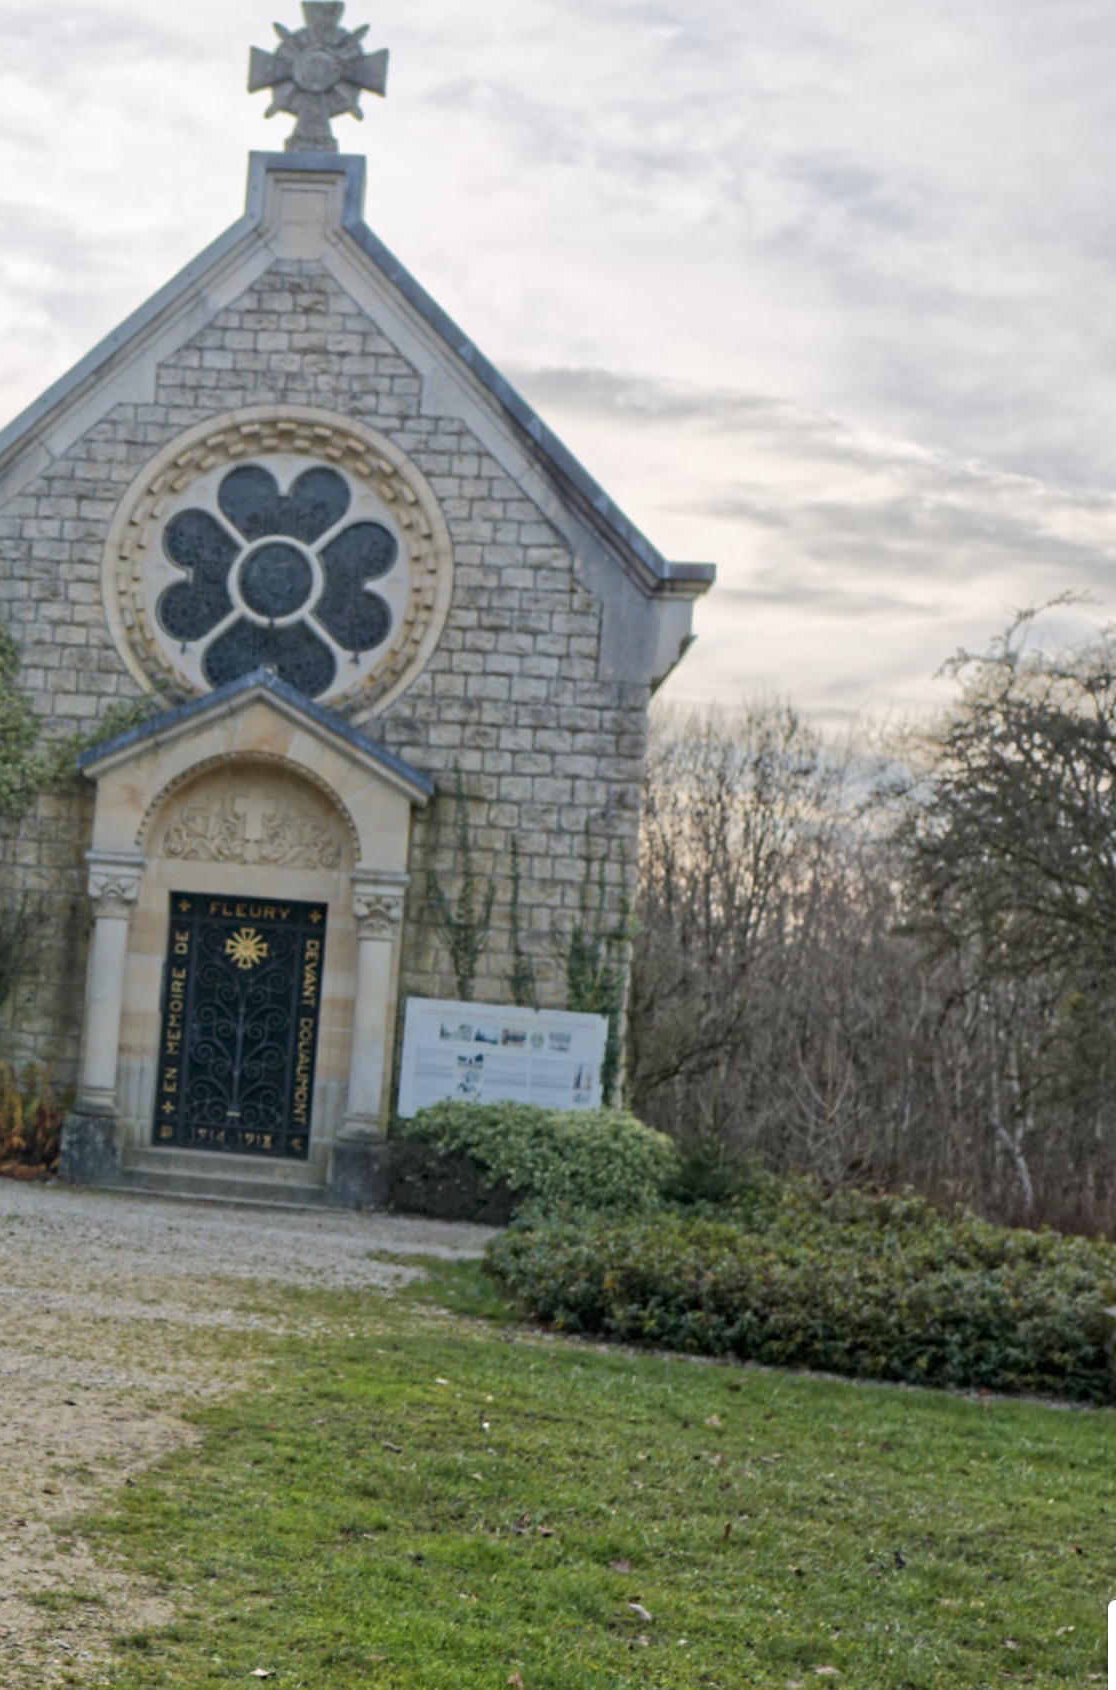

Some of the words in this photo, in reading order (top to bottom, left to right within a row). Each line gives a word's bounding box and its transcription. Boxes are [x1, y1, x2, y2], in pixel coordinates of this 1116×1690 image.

[210, 901, 291, 919] FLEURY
[174, 931, 190, 954] DE
[302, 939, 320, 1007] DEVANT
[167, 967, 187, 1055] MEMOIRE
[163, 1067, 178, 1092] EN
[293, 1018, 314, 1125] DOUAUMONT
